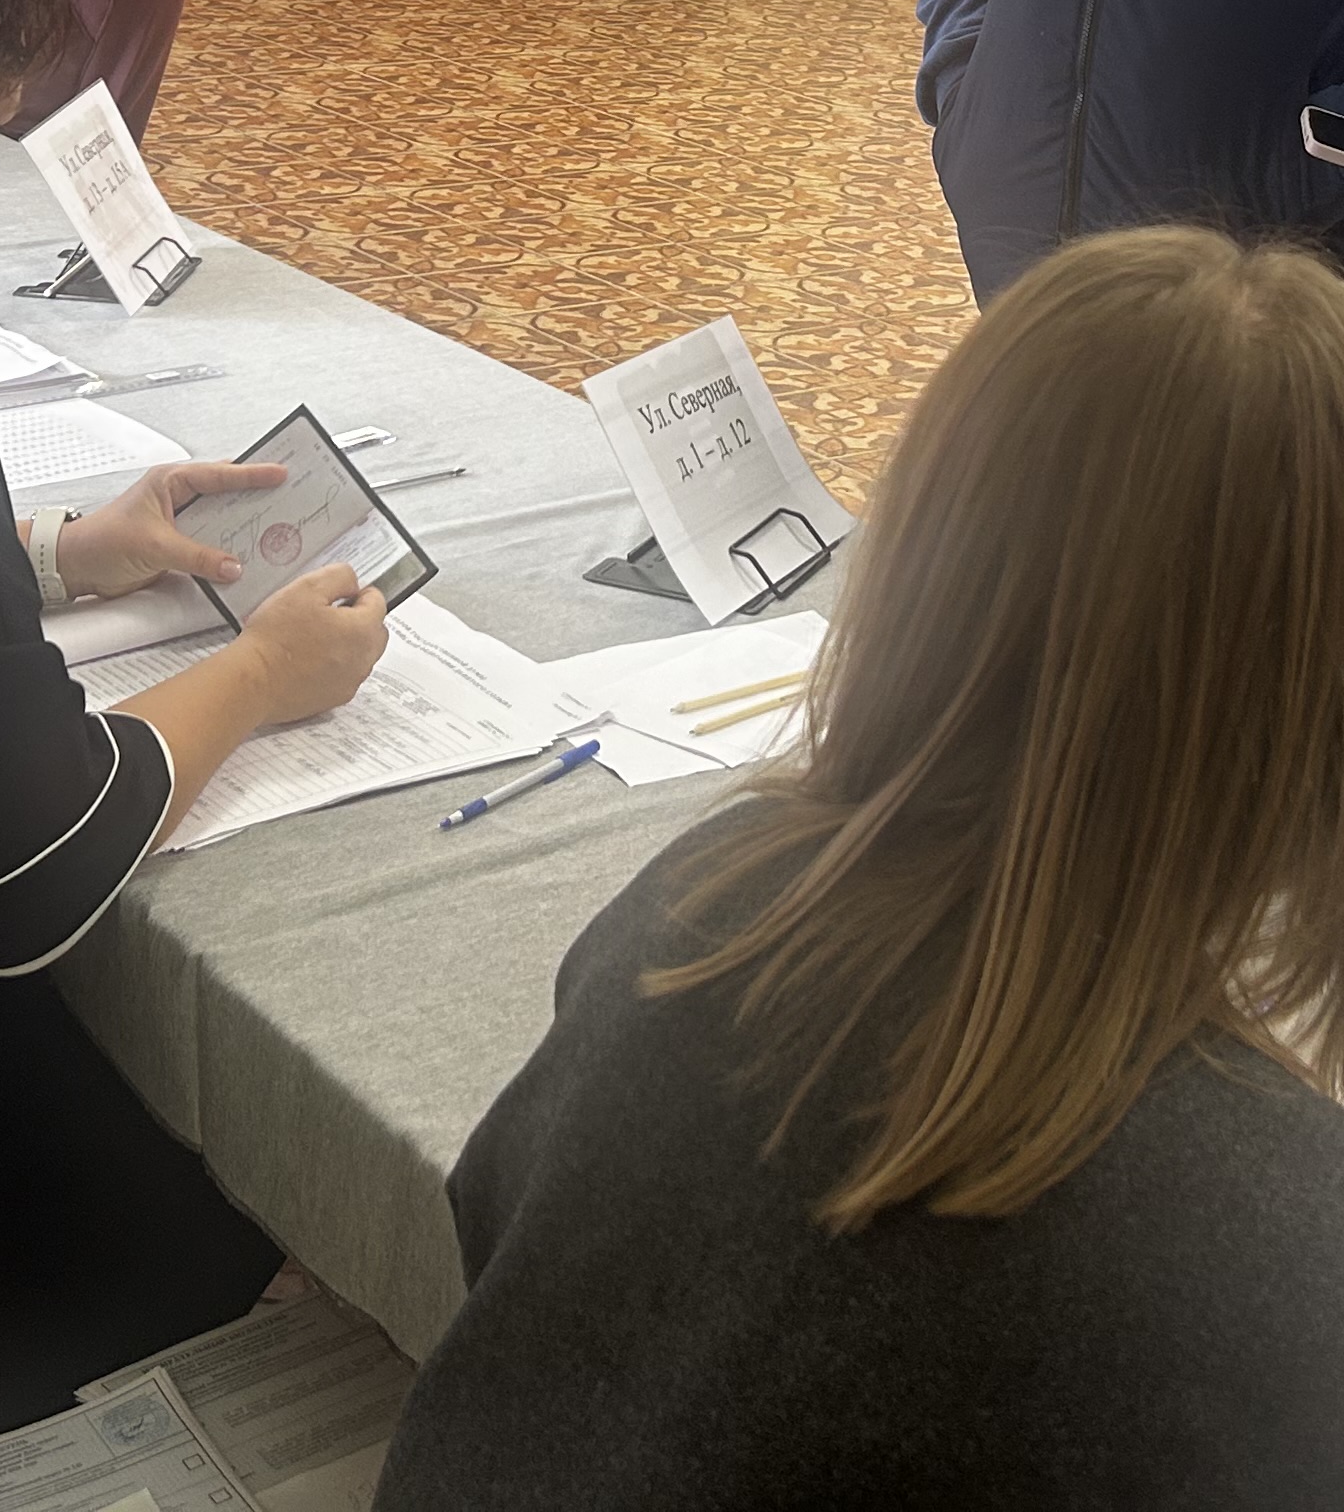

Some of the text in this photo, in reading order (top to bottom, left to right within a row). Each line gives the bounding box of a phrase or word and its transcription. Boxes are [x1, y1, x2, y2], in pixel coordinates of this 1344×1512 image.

[637, 374, 743, 435] Ул. Северная,
[675, 456, 694, 483] д.
[689, 441, 704, 469] 1
[715, 436, 734, 462] д.
[728, 418, 752, 448] 12
